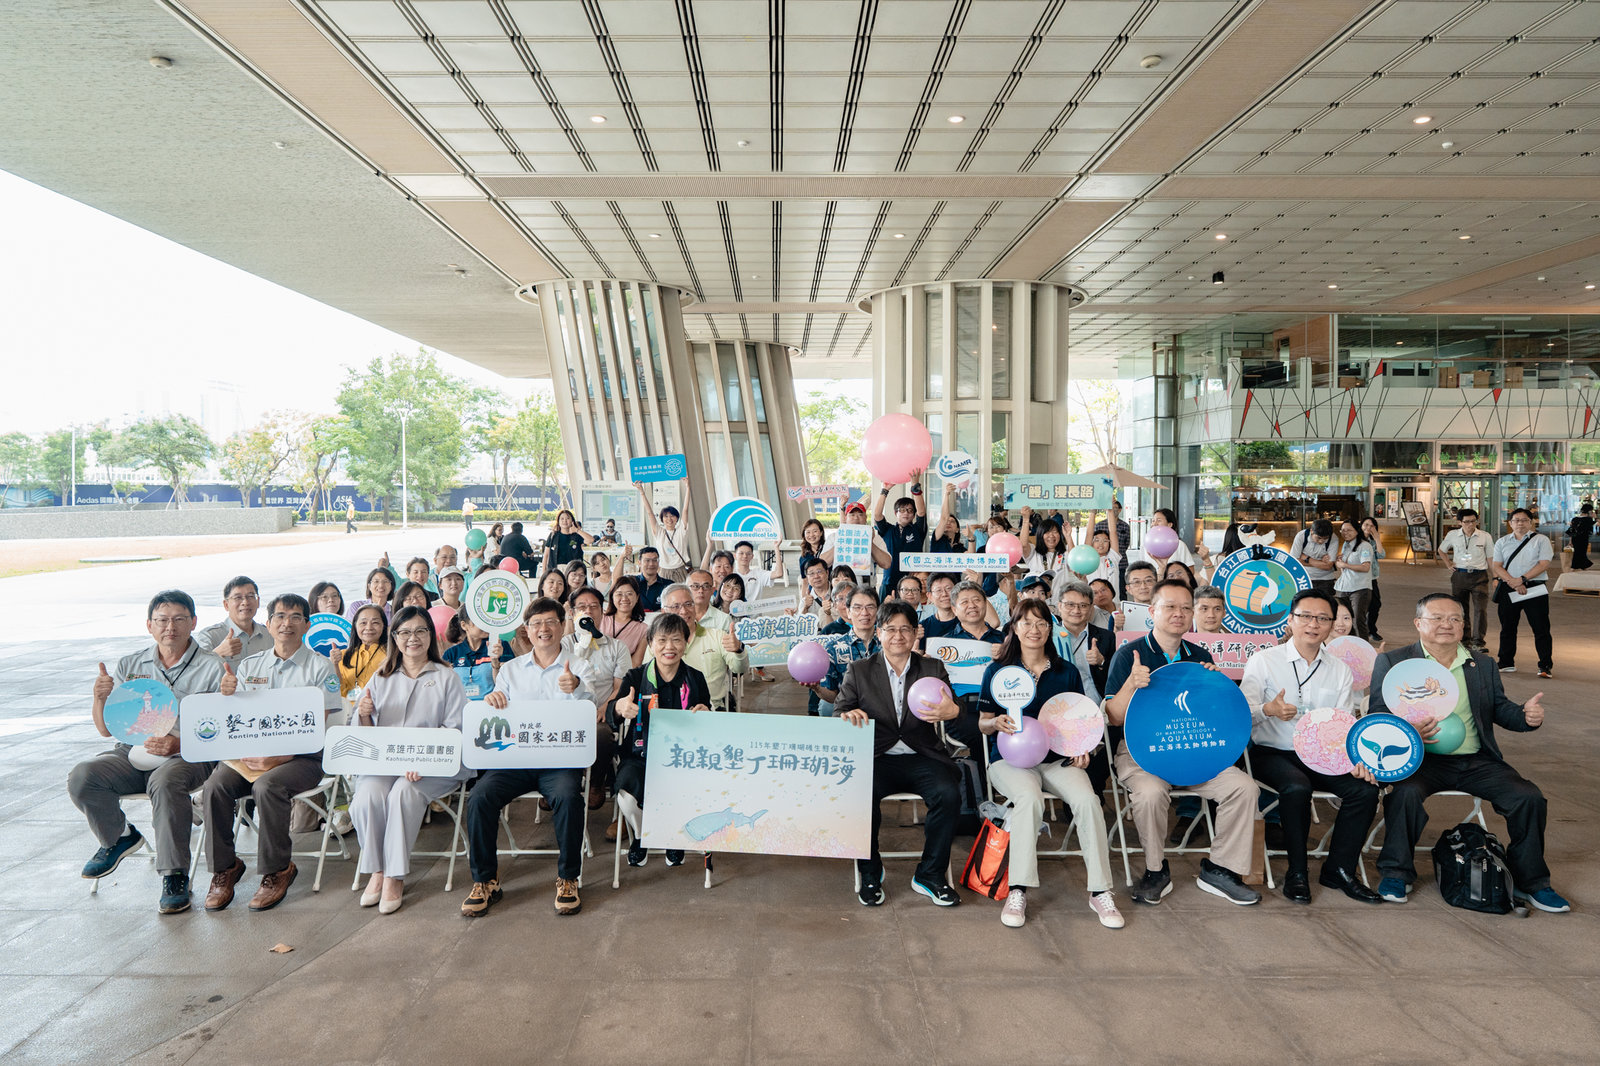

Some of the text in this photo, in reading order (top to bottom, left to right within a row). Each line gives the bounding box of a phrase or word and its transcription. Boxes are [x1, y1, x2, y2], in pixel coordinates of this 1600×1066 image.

[1218, 548, 1289, 578] 台江國公園
[1166, 722, 1206, 730] MUSEUM
[518, 730, 587, 744] 國家公園署
[1160, 733, 1213, 743] AQUARIUM
[386, 744, 455, 755] 高雄市立圖書館
[1149, 740, 1226, 752] 國立海洋生物博物館
[661, 743, 856, 785] 親親墾丁珊瑚海
